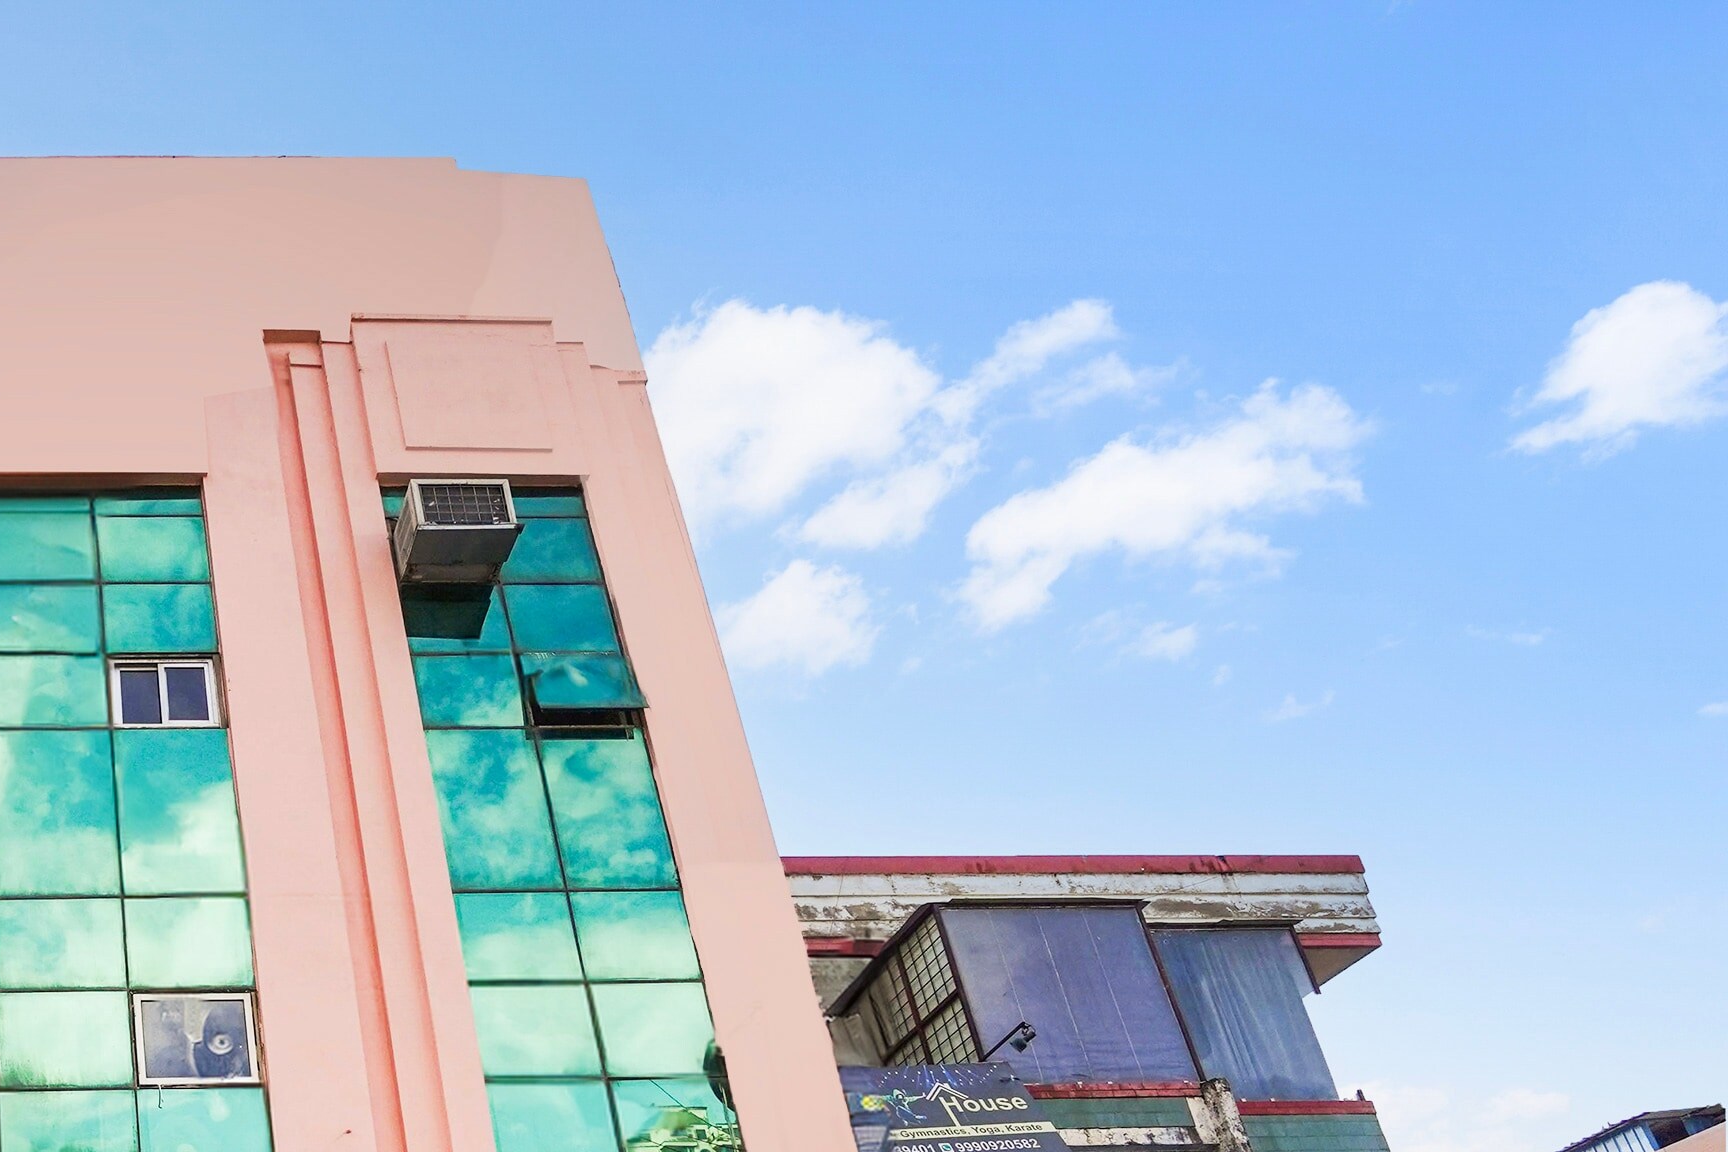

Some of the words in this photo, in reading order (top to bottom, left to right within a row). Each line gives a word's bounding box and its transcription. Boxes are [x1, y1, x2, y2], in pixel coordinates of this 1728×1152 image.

[939, 1095, 1029, 1126] House
[900, 1127, 971, 1139] Gymnastics,
[972, 1125, 1003, 1136] Yoga,
[1005, 1123, 1043, 1133] Karate
